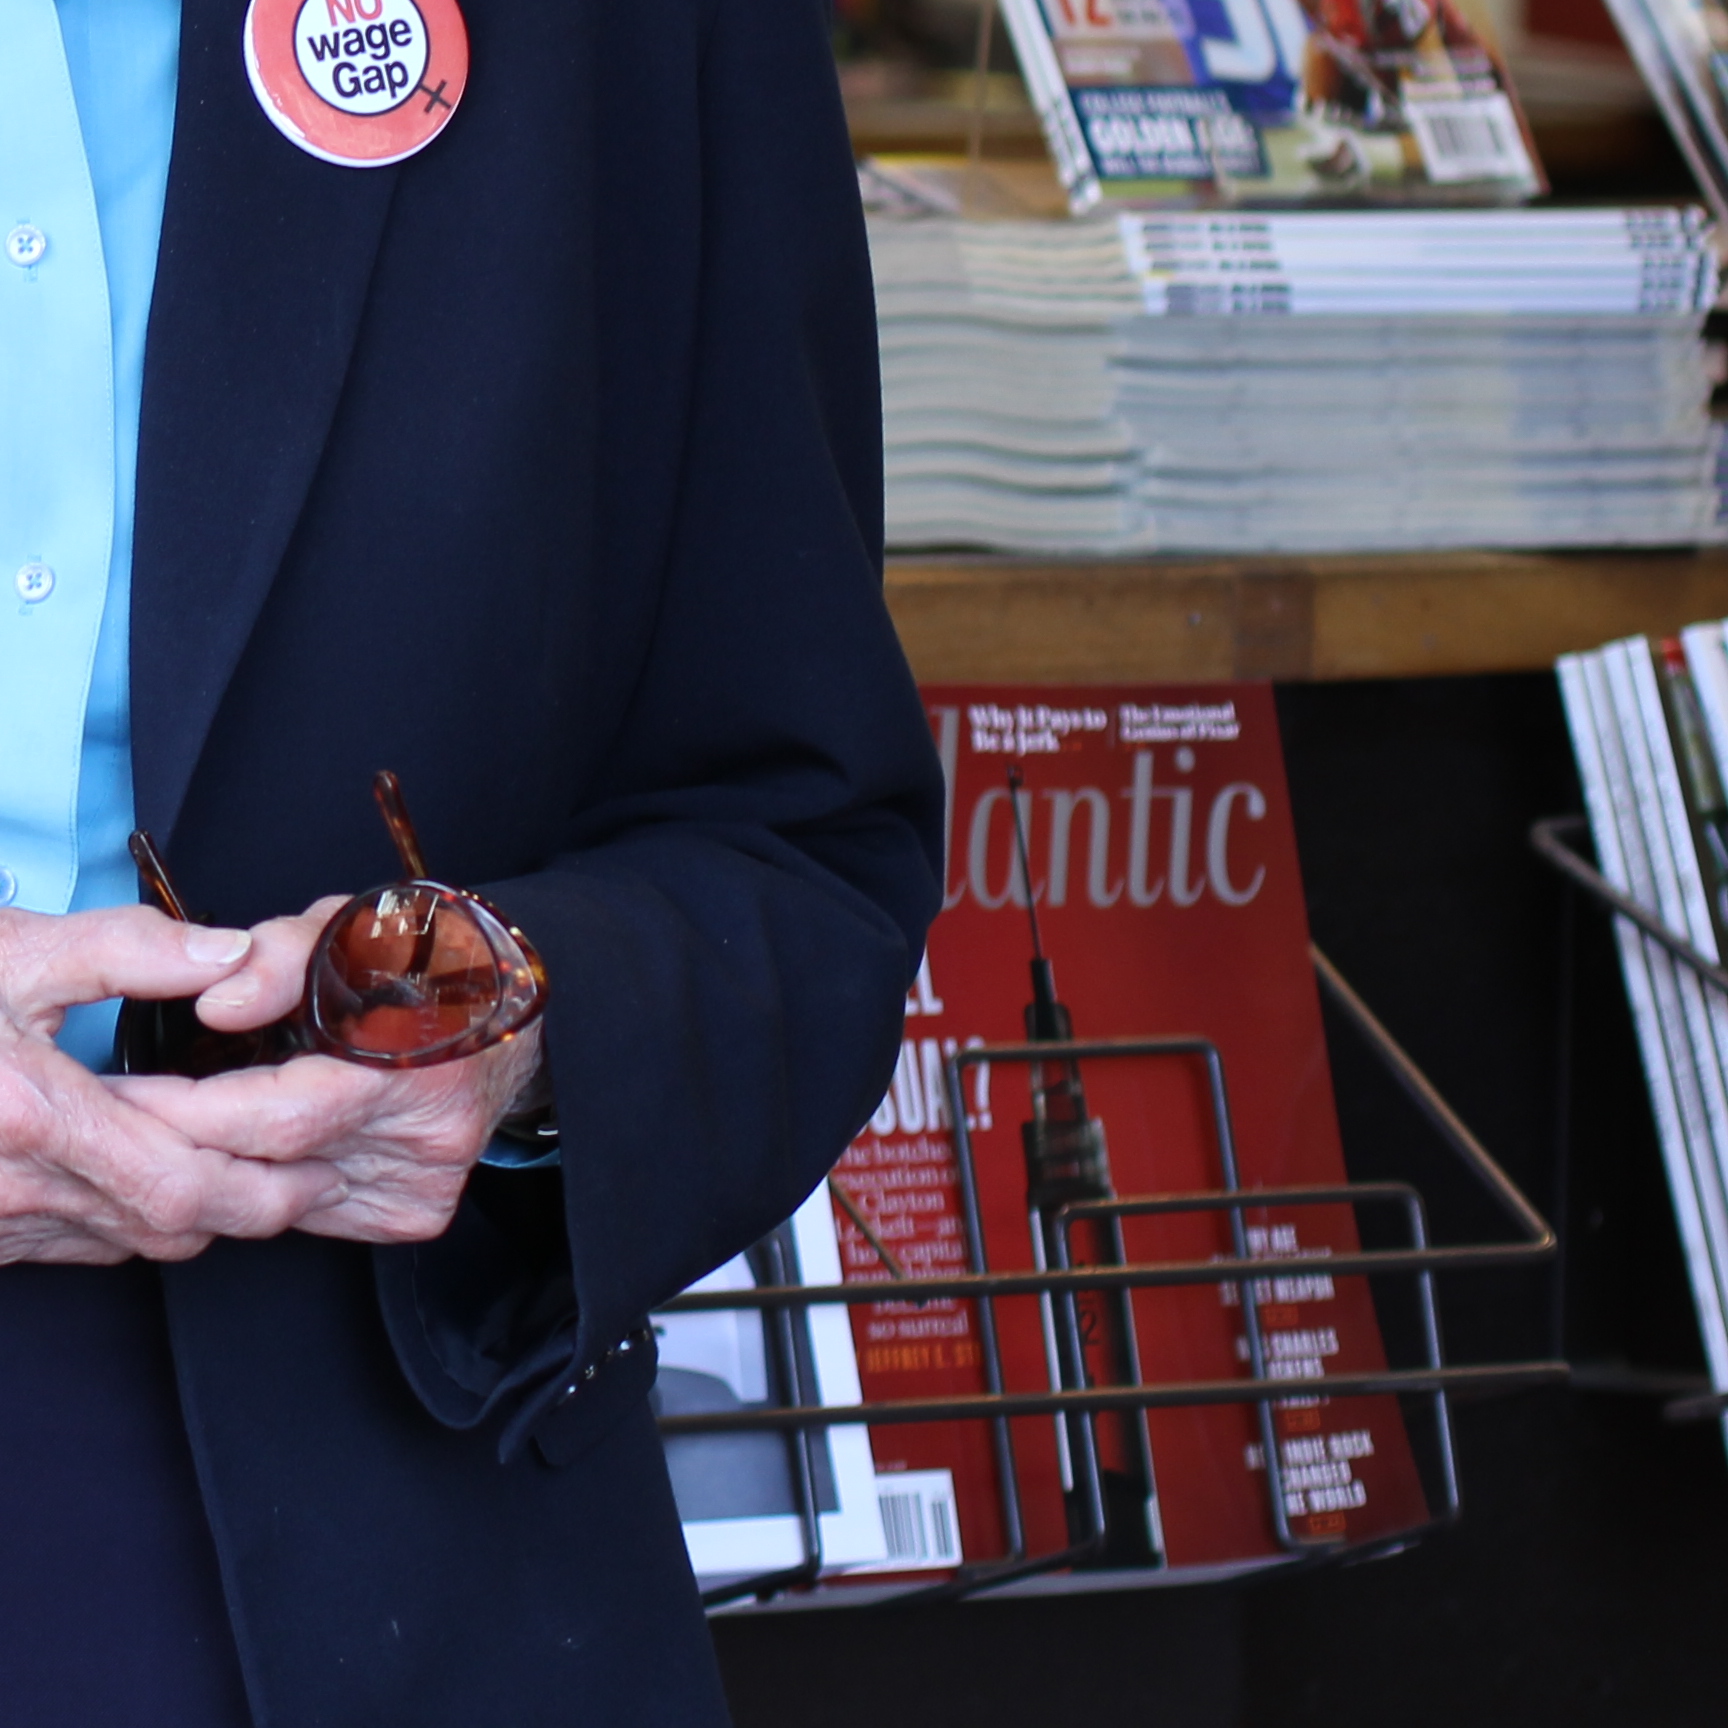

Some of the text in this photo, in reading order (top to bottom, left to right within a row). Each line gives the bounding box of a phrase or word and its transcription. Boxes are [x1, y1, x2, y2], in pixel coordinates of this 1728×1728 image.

[307, 18, 413, 63] wage
[331, 60, 410, 99] Gap
[943, 705, 1267, 910] lantic
